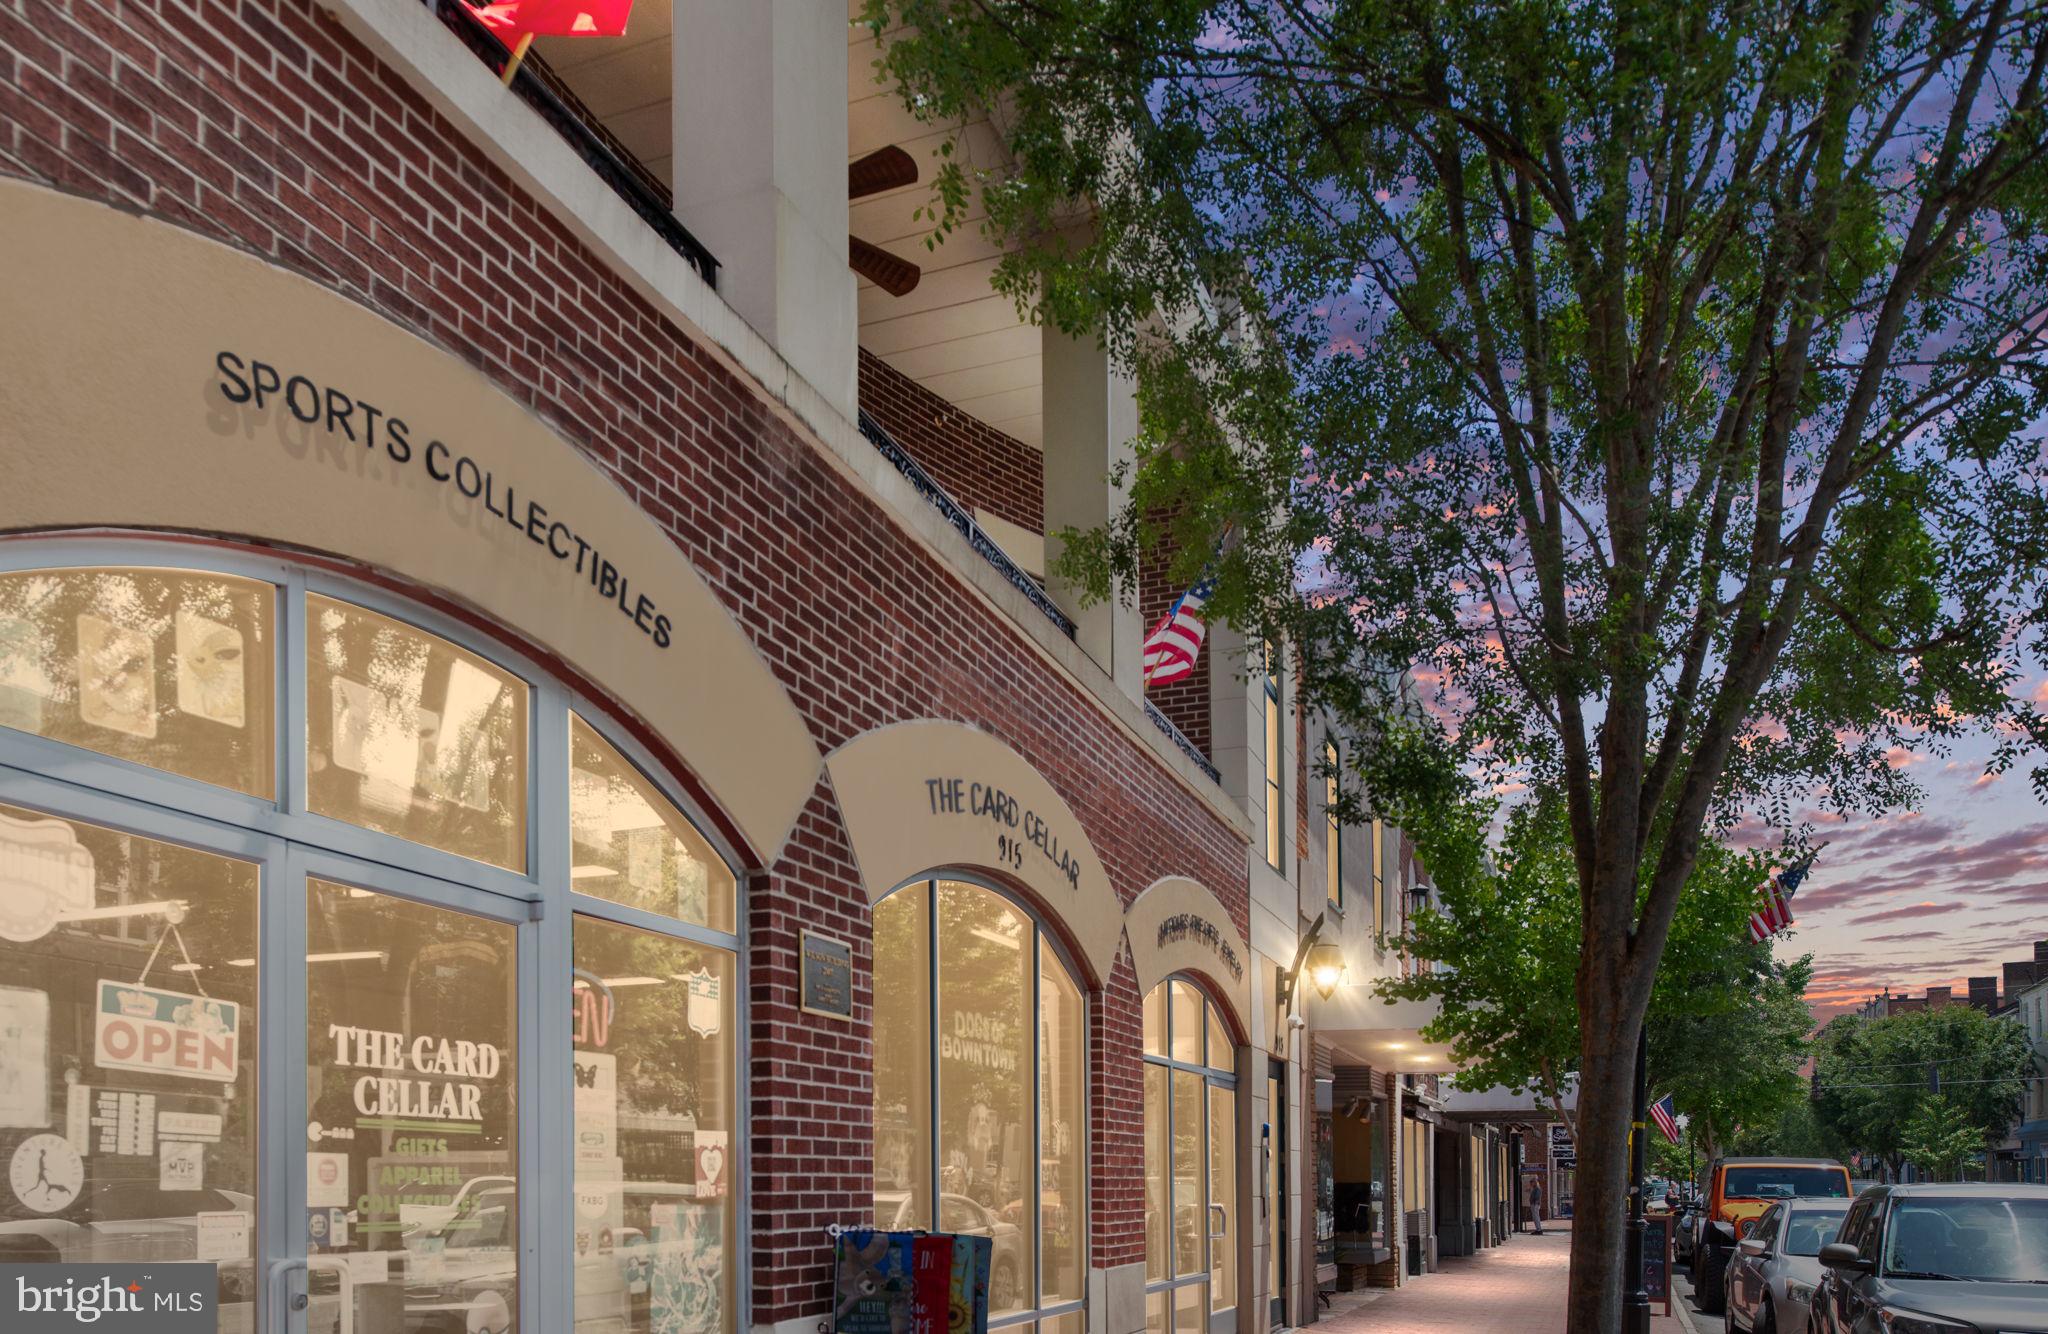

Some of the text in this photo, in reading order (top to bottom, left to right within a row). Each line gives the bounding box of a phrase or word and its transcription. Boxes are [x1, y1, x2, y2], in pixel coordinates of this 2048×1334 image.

[216, 351, 672, 649] SPORTS COLLECTIBLES
[925, 777, 1080, 890] THE CARD CELLAR
[998, 834, 1022, 870] 915
[102, 1020, 234, 1072] OPEN
[328, 1023, 500, 1079] THE CARD
[353, 1075, 484, 1121] CELLAR
[168, 1158, 194, 1174] MVP
[396, 1137, 448, 1158] GIFTS
[380, 1166, 463, 1186] APPAREL
[581, 1196, 604, 1205] FXBG
